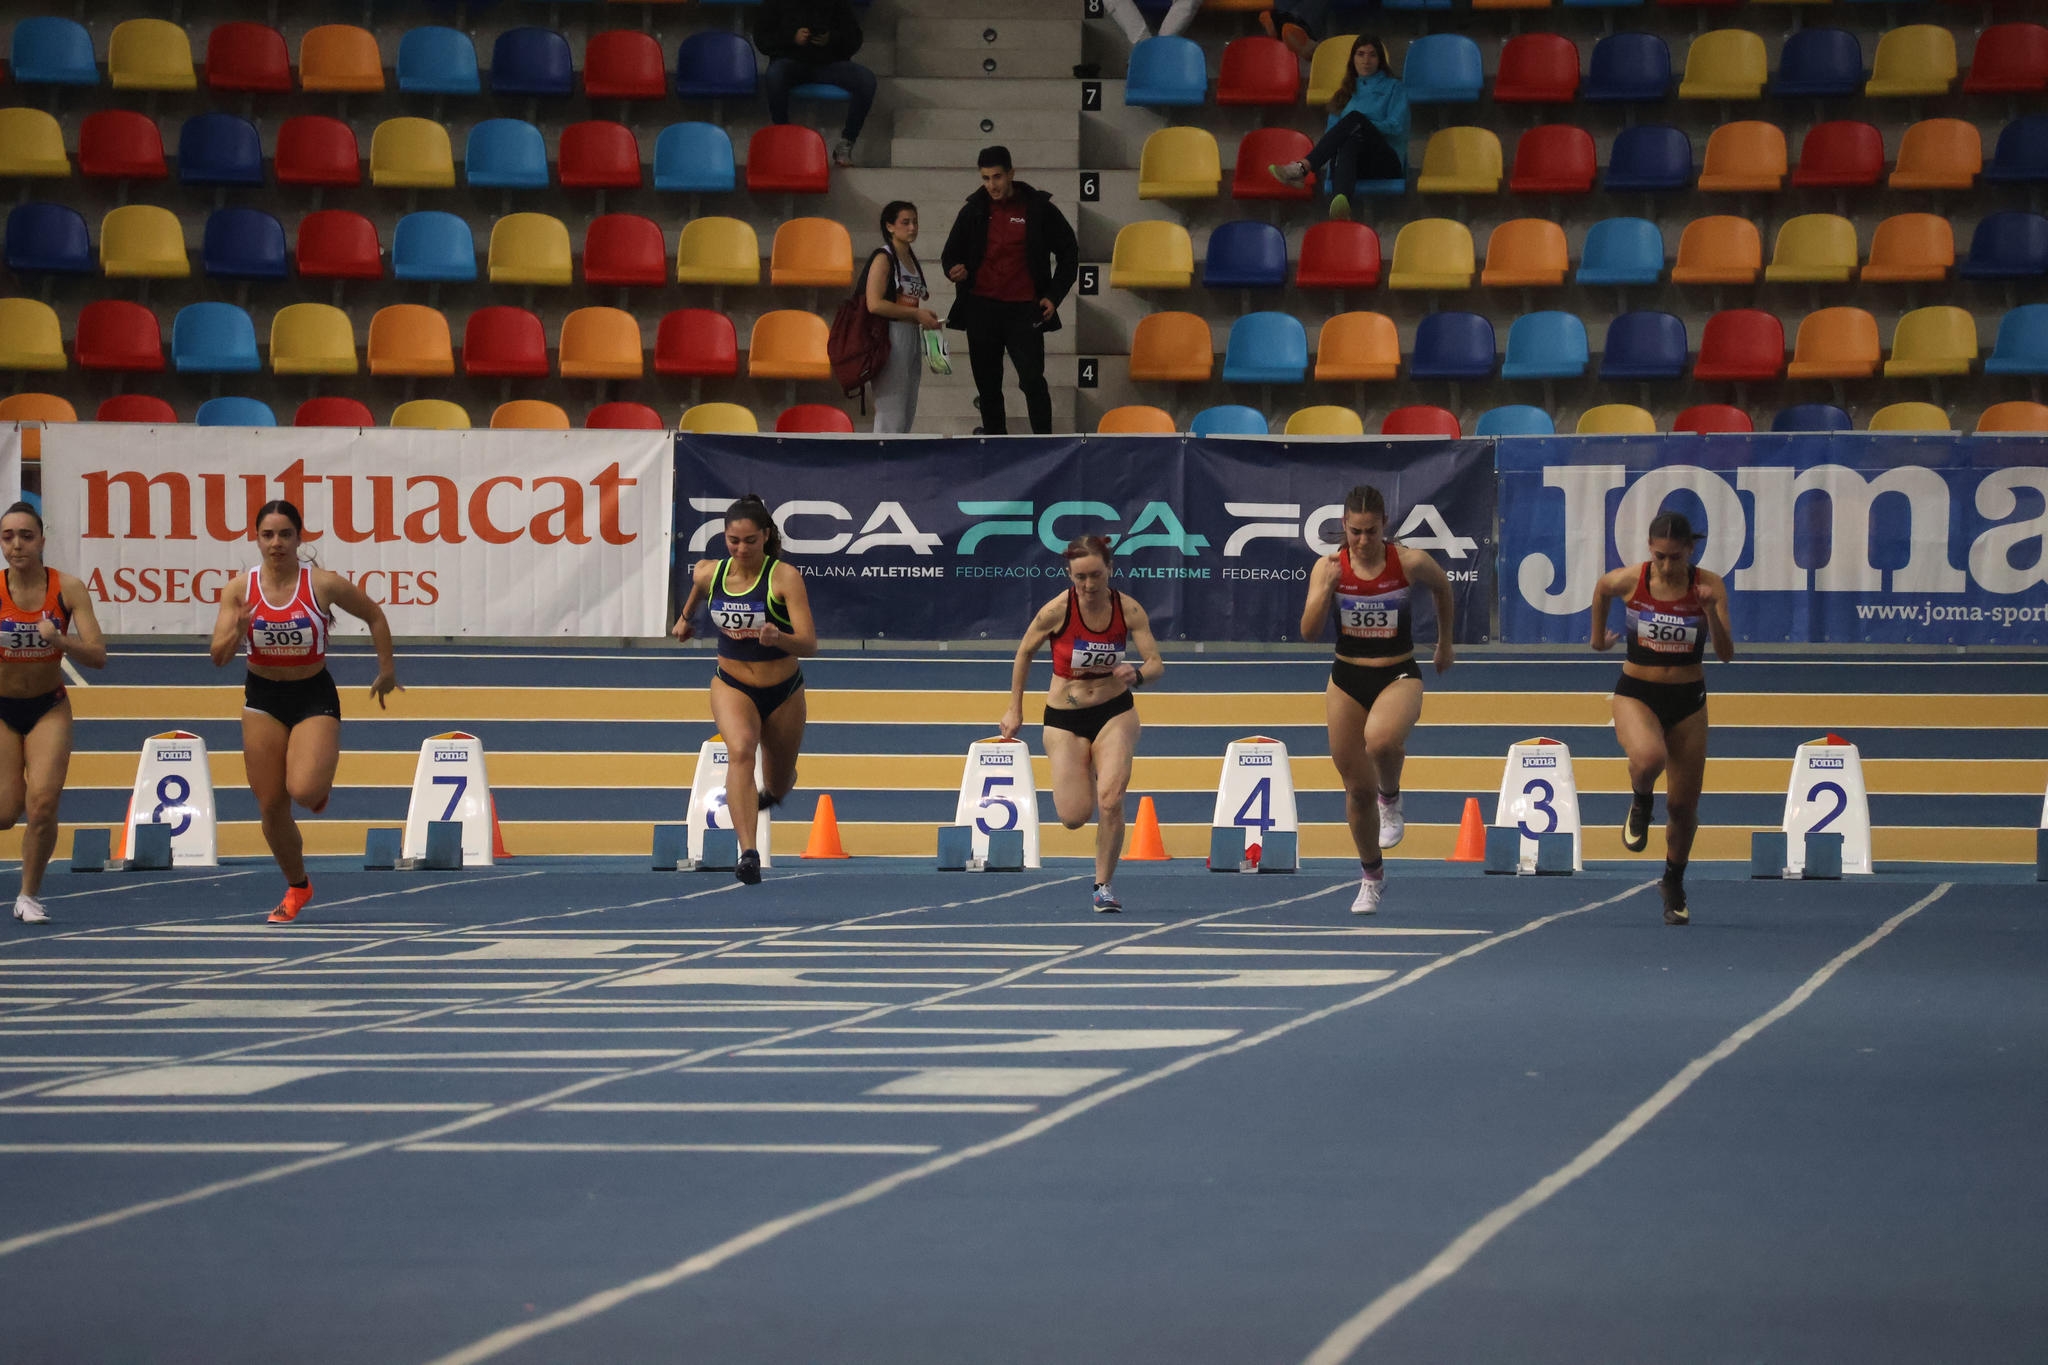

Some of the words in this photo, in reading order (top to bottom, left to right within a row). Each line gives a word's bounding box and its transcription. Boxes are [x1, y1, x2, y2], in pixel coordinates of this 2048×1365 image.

[1088, 0, 1100, 13] 8
[1086, 88, 1097, 105] 7
[1084, 178, 1095, 195] 6
[1083, 272, 1094, 289] 5
[1082, 365, 1094, 381] 4
[81, 459, 637, 545] mutuacat
[957, 500, 1211, 556] FCA
[1518, 464, 2048, 615] Joma
[861, 566, 944, 577] ATLETISME
[956, 564, 1041, 578] FEDERACIÓ
[1129, 567, 1211, 578] ATLETISME
[1223, 566, 1307, 581] FEDERACIÓ
[87, 567, 440, 606] ASSEGCES
[14, 622, 38, 632] Jom
[720, 612, 755, 630] 297
[1350, 611, 1389, 628] 363
[263, 630, 304, 646] 309
[1646, 623, 1687, 642] 360
[1080, 651, 1117, 668] 260
[153, 774, 191, 836] 8
[432, 776, 468, 821] 7
[976, 777, 1018, 836] 5
[1233, 777, 1276, 836] 4
[1807, 781, 1847, 833] 2
[1518, 778, 1558, 841] 3
